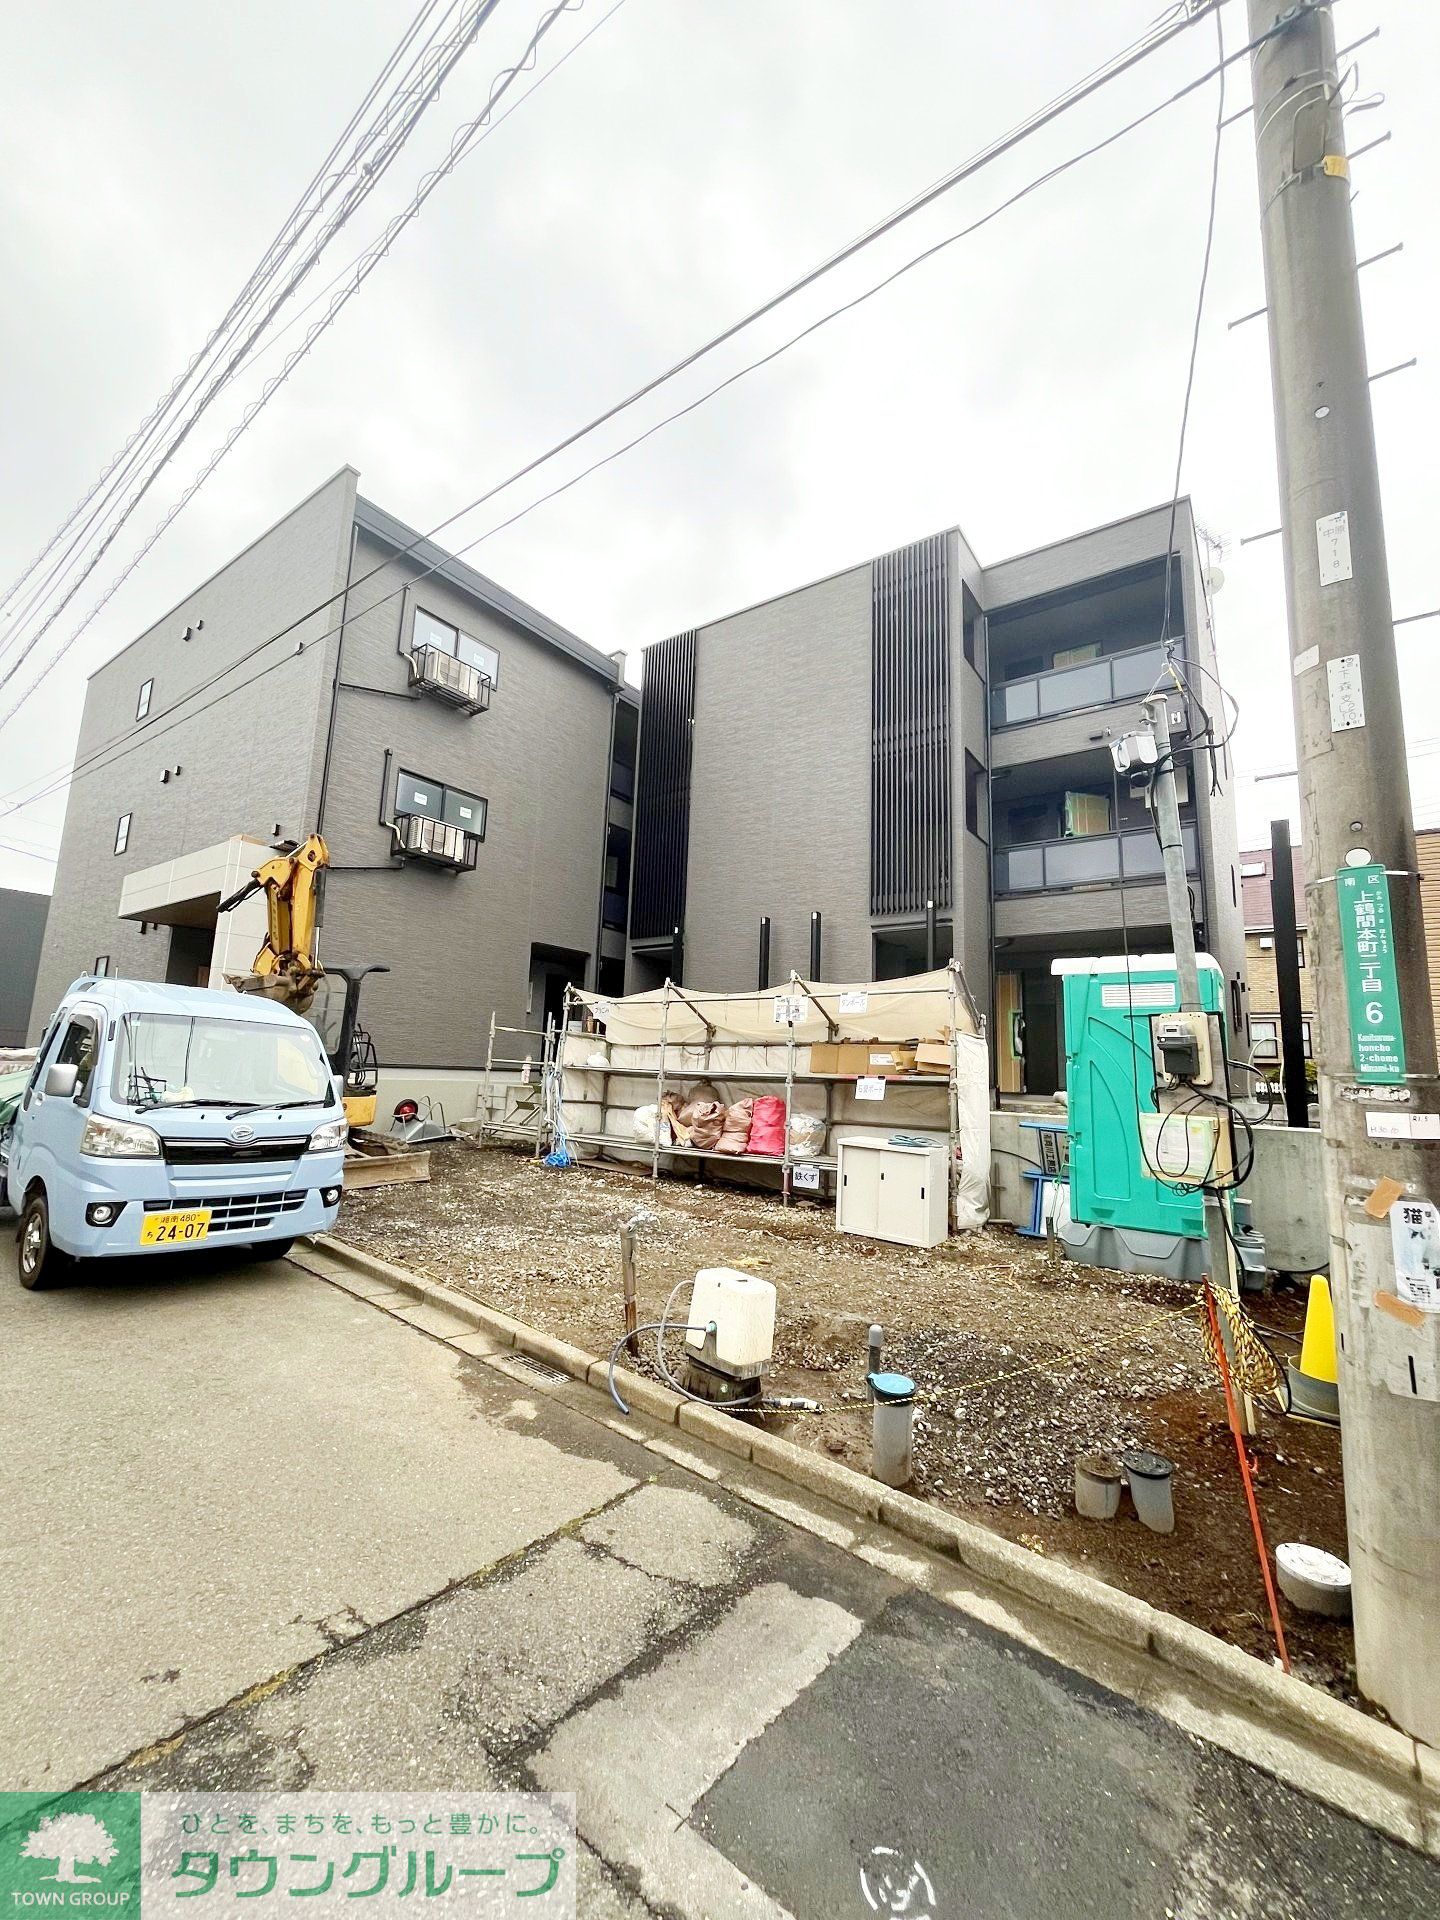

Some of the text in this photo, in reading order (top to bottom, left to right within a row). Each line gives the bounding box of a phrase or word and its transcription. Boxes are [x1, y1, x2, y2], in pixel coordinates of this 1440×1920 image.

[1344, 874, 1380, 887] 南区
[1353, 890, 1383, 993] 上鶴間本町二丁目
[1365, 1001, 1384, 1024] 6
[1358, 1043, 1391, 1052] honcho
[1359, 1053, 1399, 1063] 2-chome
[794, 1171, 818, 1182] 鉄くず
[179, 1213, 197, 1222] 480
[1403, 1207, 1424, 1225] 猫
[155, 1222, 206, 1242] 24-07
